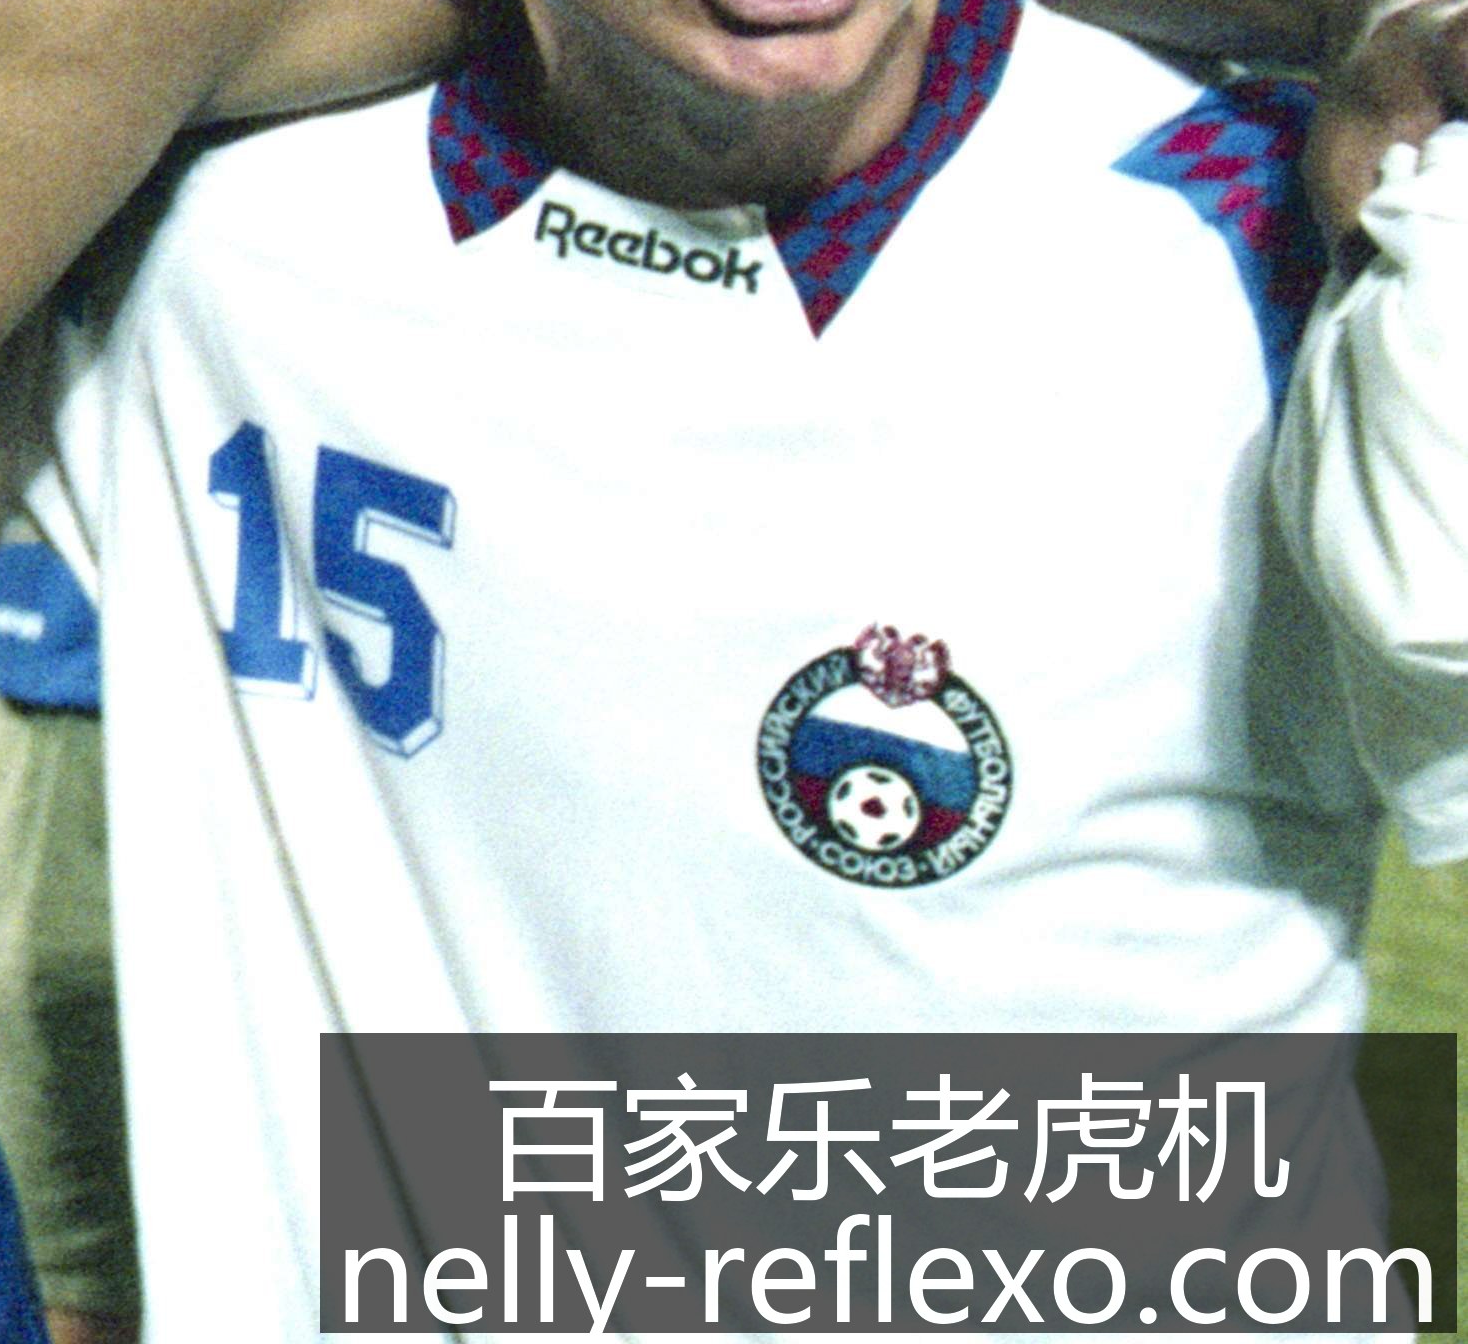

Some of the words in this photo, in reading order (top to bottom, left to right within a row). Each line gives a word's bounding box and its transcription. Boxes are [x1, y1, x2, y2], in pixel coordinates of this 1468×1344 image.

[532, 199, 764, 295] Reebok
[208, 419, 458, 761] 15
[759, 654, 850, 846] РОССИЙСКИЙ
[929, 687, 1008, 875] ФУТБОЛЬНЫЙ
[820, 842, 917, 881] СОЮЗ
